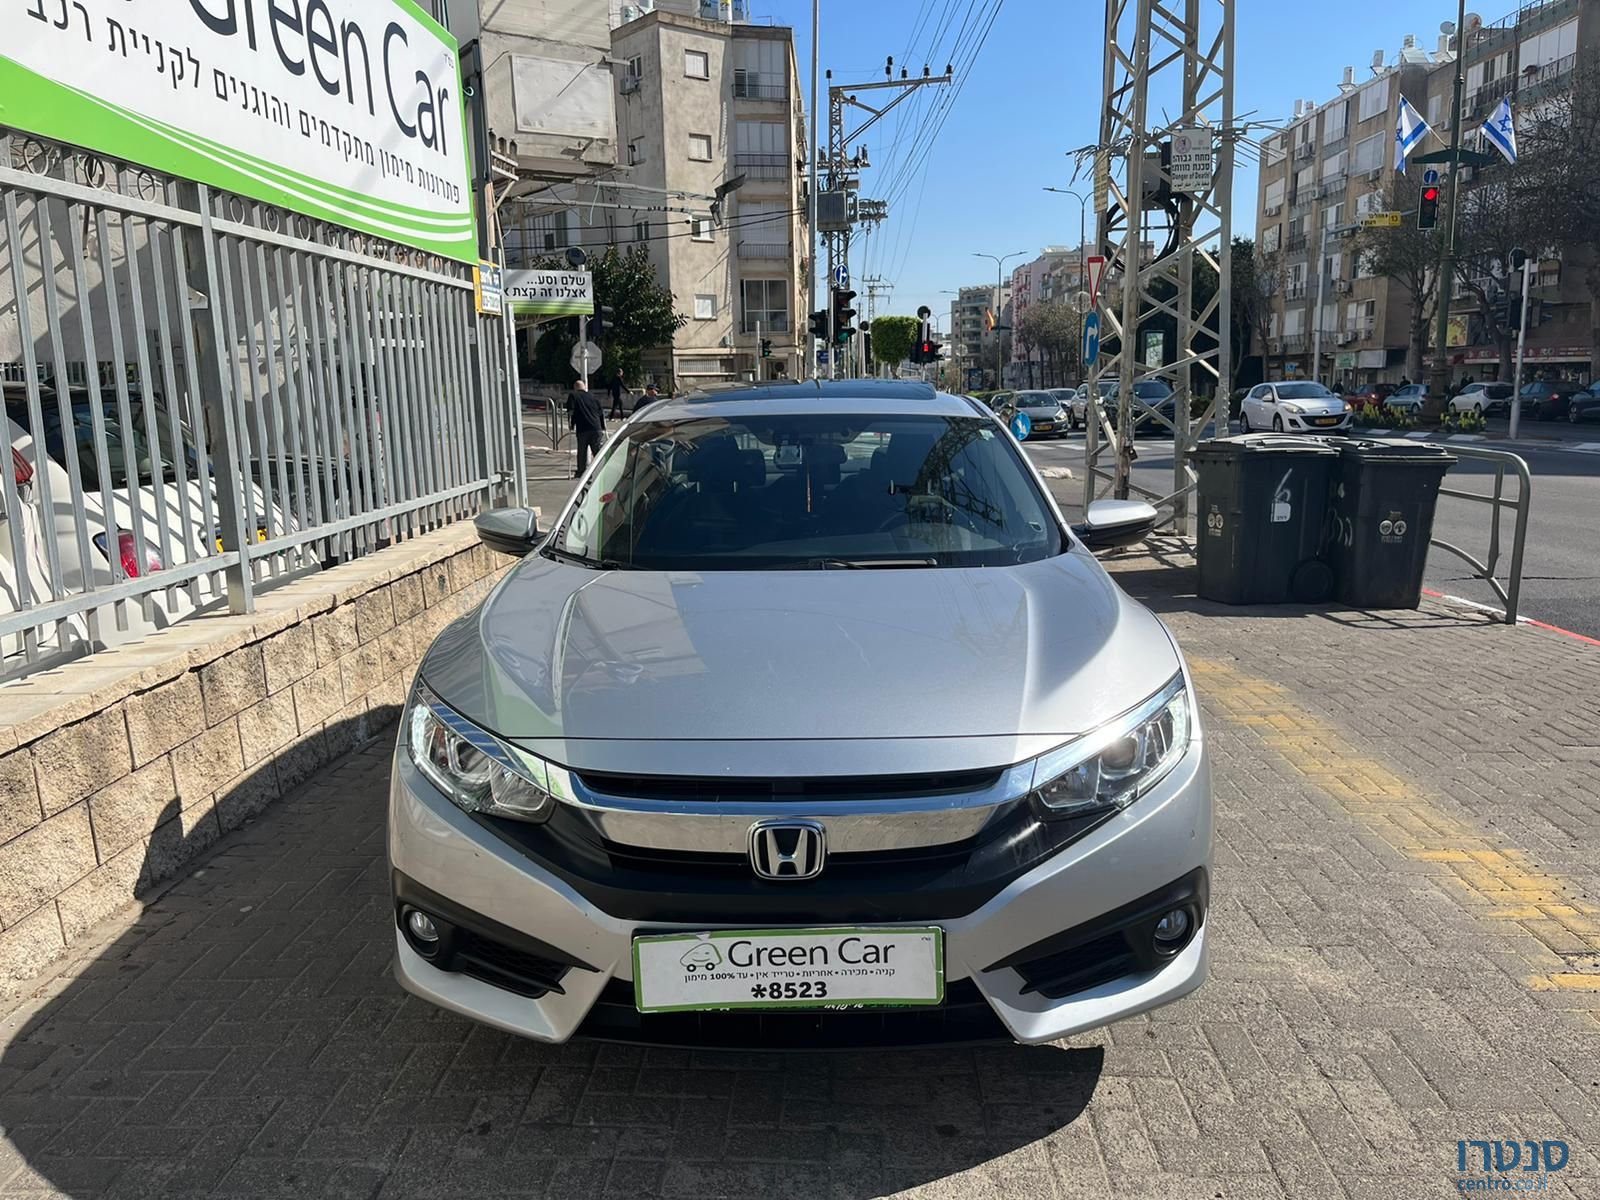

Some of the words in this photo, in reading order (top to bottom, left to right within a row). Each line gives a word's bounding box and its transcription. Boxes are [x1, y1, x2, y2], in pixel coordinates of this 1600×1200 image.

[106, 17, 200, 89] לקניית
[383, 21, 449, 156] Car
[213, 68, 291, 129] והוגנים
[299, 109, 375, 166] מתקדמים
[379, 149, 414, 184] מימון
[417, 168, 460, 204] פתרונות
[561, 274, 586, 286] שלם
[512, 286, 537, 299] קצת
[540, 287, 553, 297] זה
[556, 286, 586, 298] אצלנו
[728, 940, 828, 967] Green
[838, 937, 895, 965] Car
[684, 973, 707, 983] מימון
[710, 972, 735, 980] 100%
[736, 971, 748, 979] עד
[756, 971, 769, 980] אין
[771, 970, 795, 978] טרייד
[802, 969, 833, 977] אחריות
[841, 968, 868, 976] מכירה
[875, 968, 895, 977] קניה
